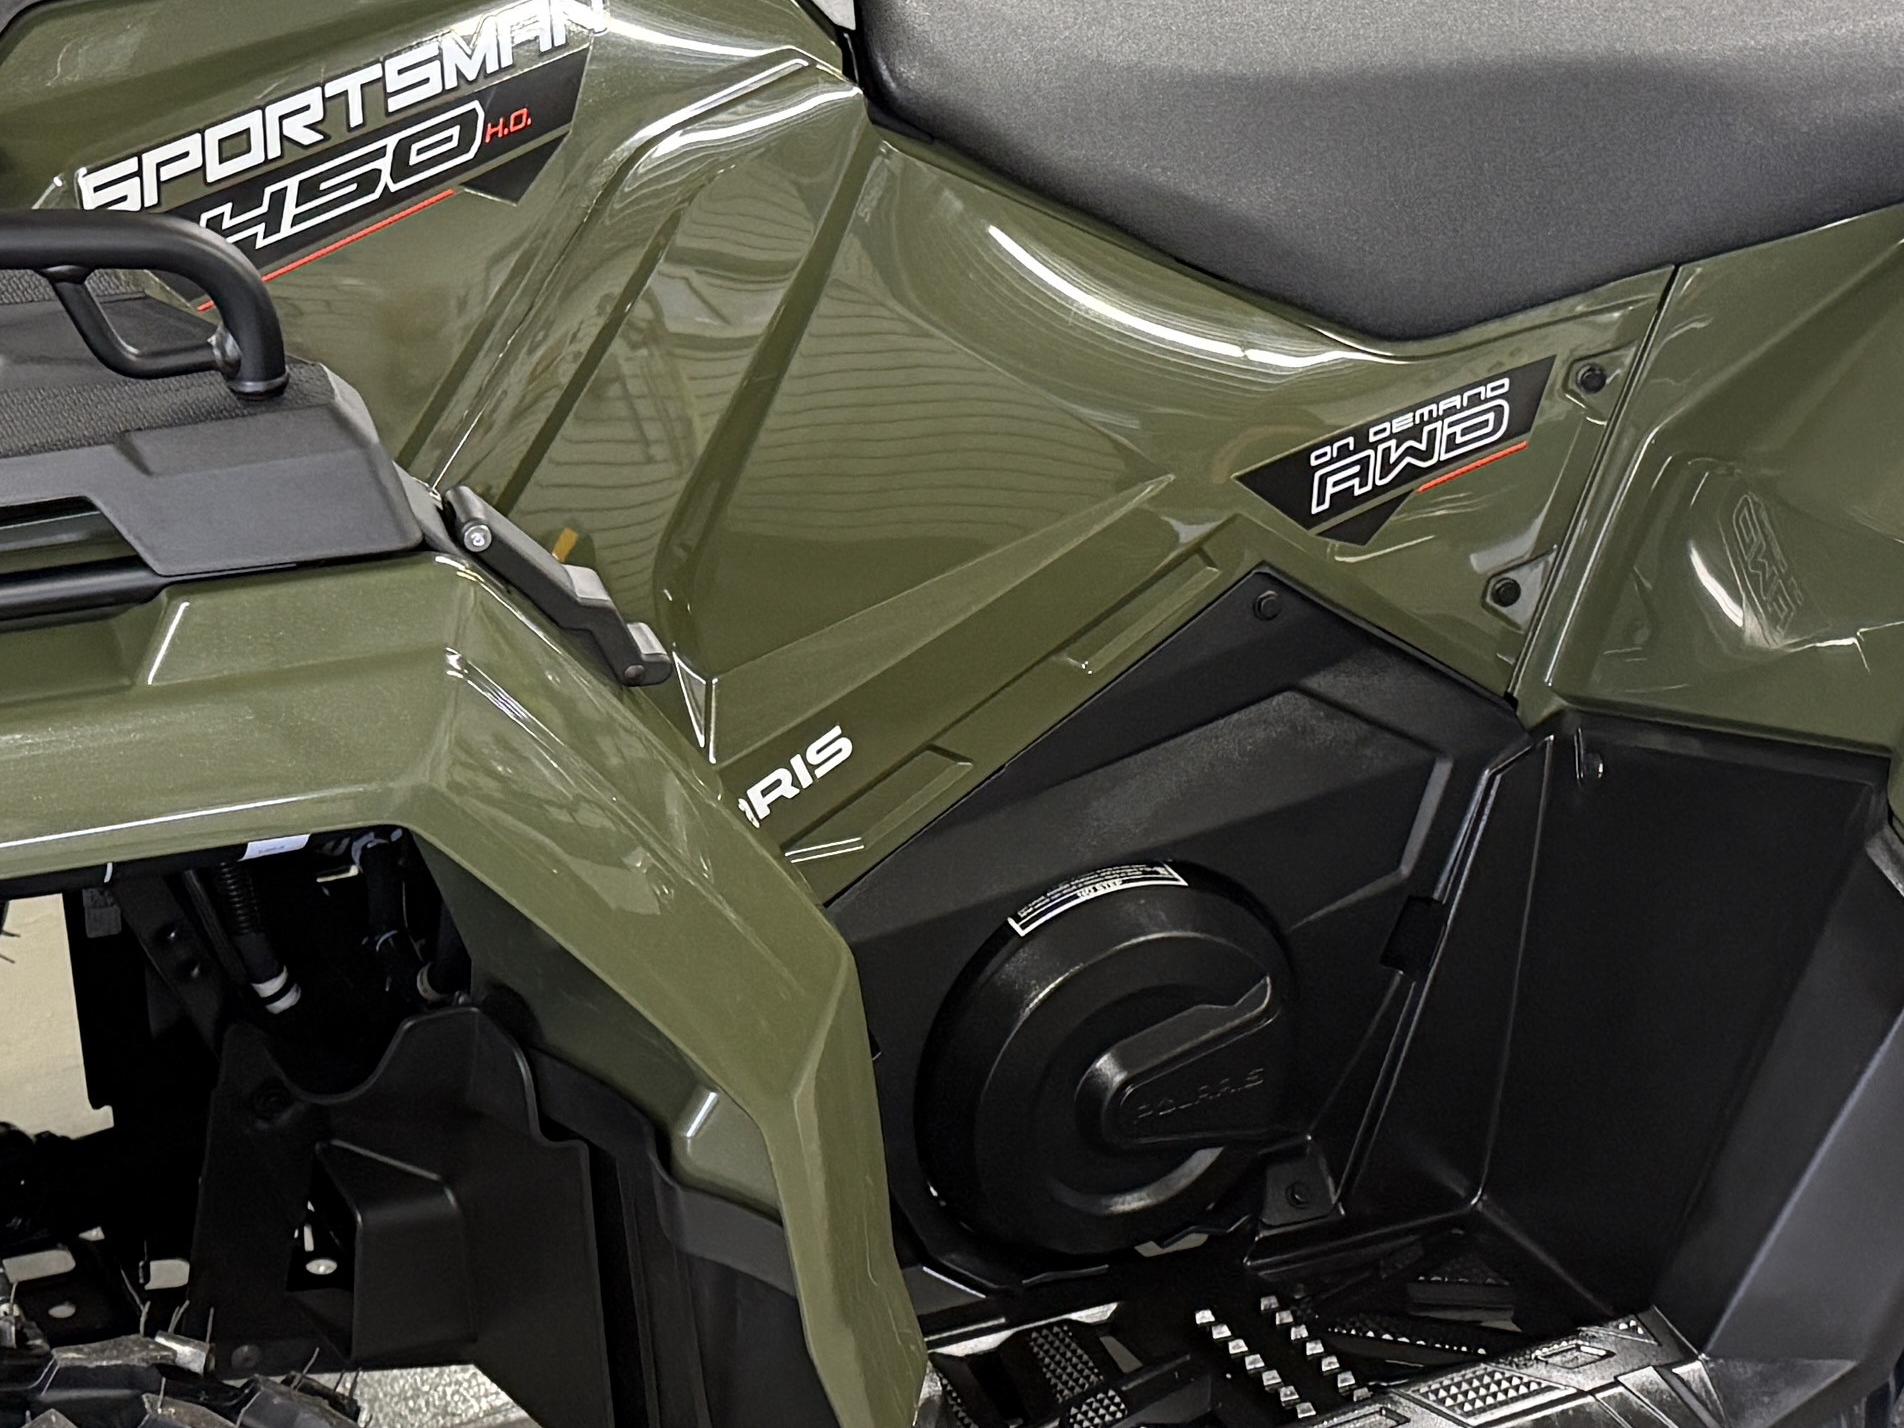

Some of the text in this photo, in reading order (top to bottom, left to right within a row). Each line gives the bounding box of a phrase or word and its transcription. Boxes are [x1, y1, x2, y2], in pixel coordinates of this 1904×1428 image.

[1309, 377, 1510, 467] ON DEMAND
[1311, 398, 1510, 515] AWD
